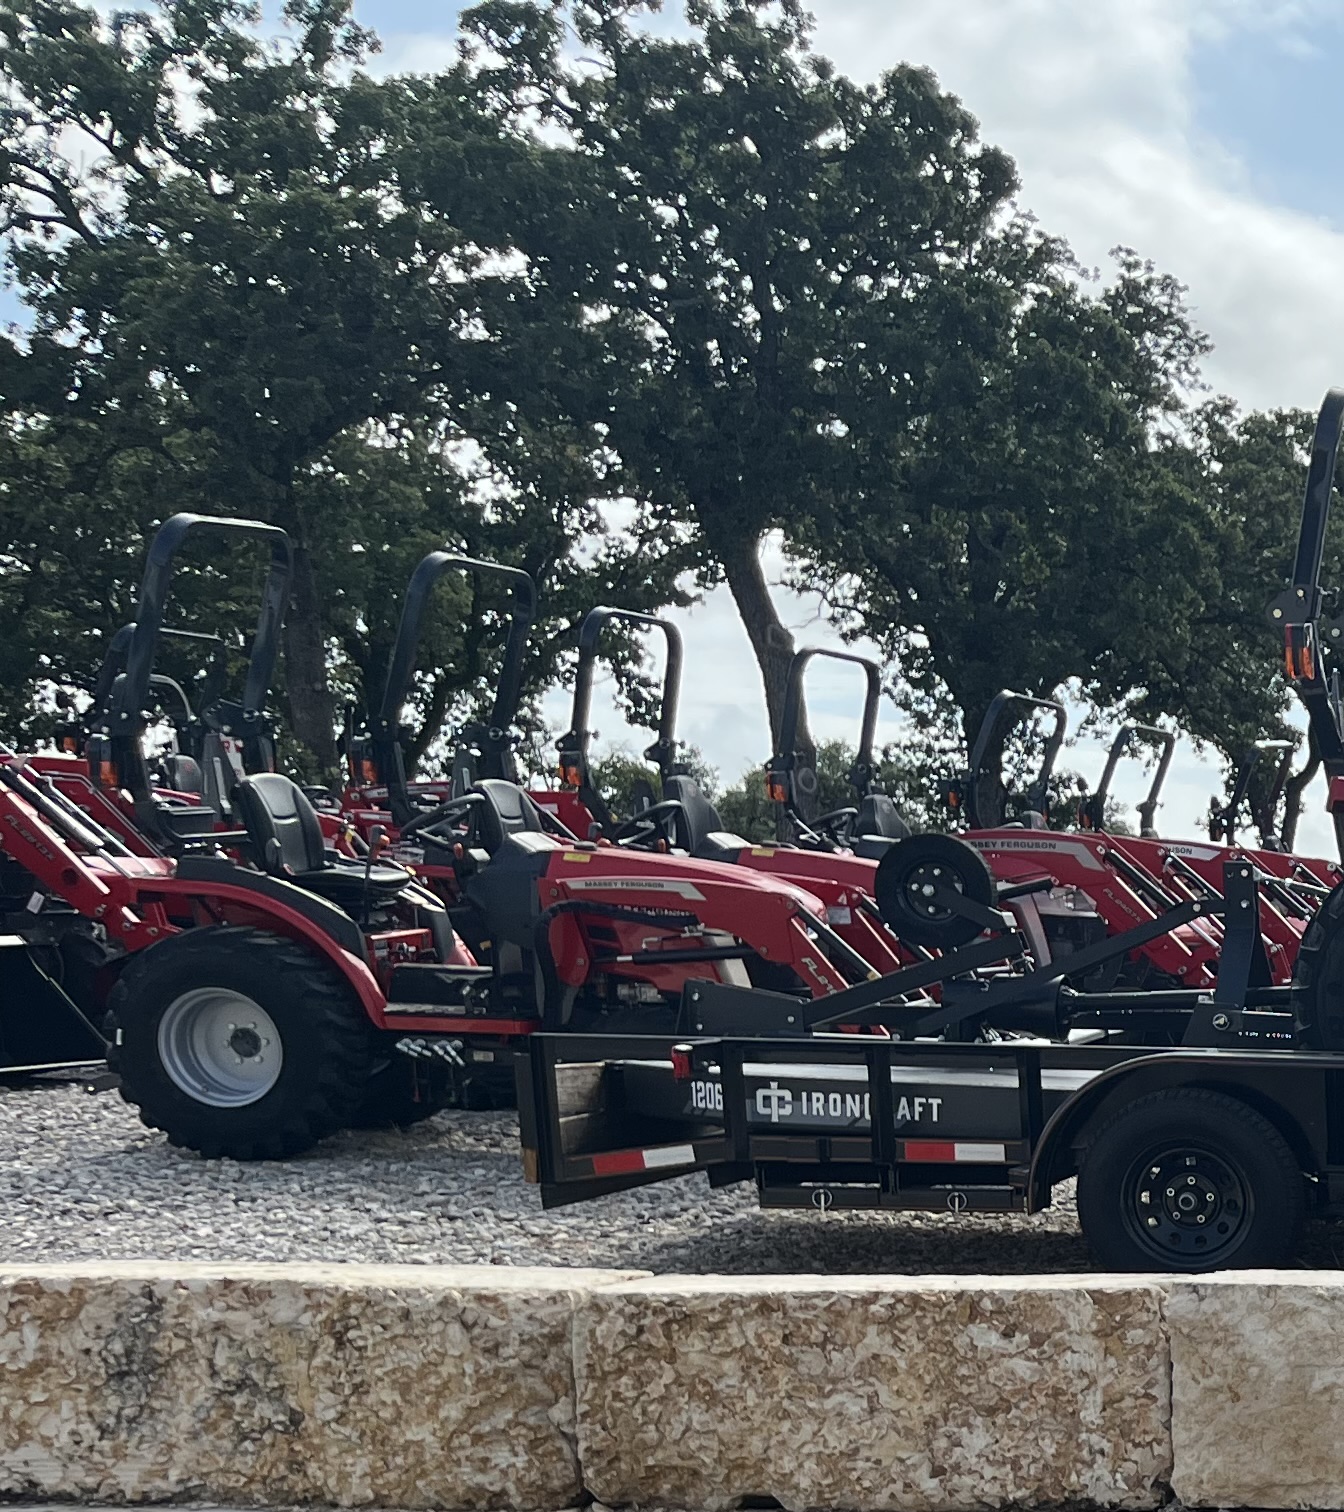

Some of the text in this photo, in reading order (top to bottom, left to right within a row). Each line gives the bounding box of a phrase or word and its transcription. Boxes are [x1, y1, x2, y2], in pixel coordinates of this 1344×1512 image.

[970, 840, 1057, 850] SSEY FERGUSON
[801, 1090, 943, 1123] IRONAFT
